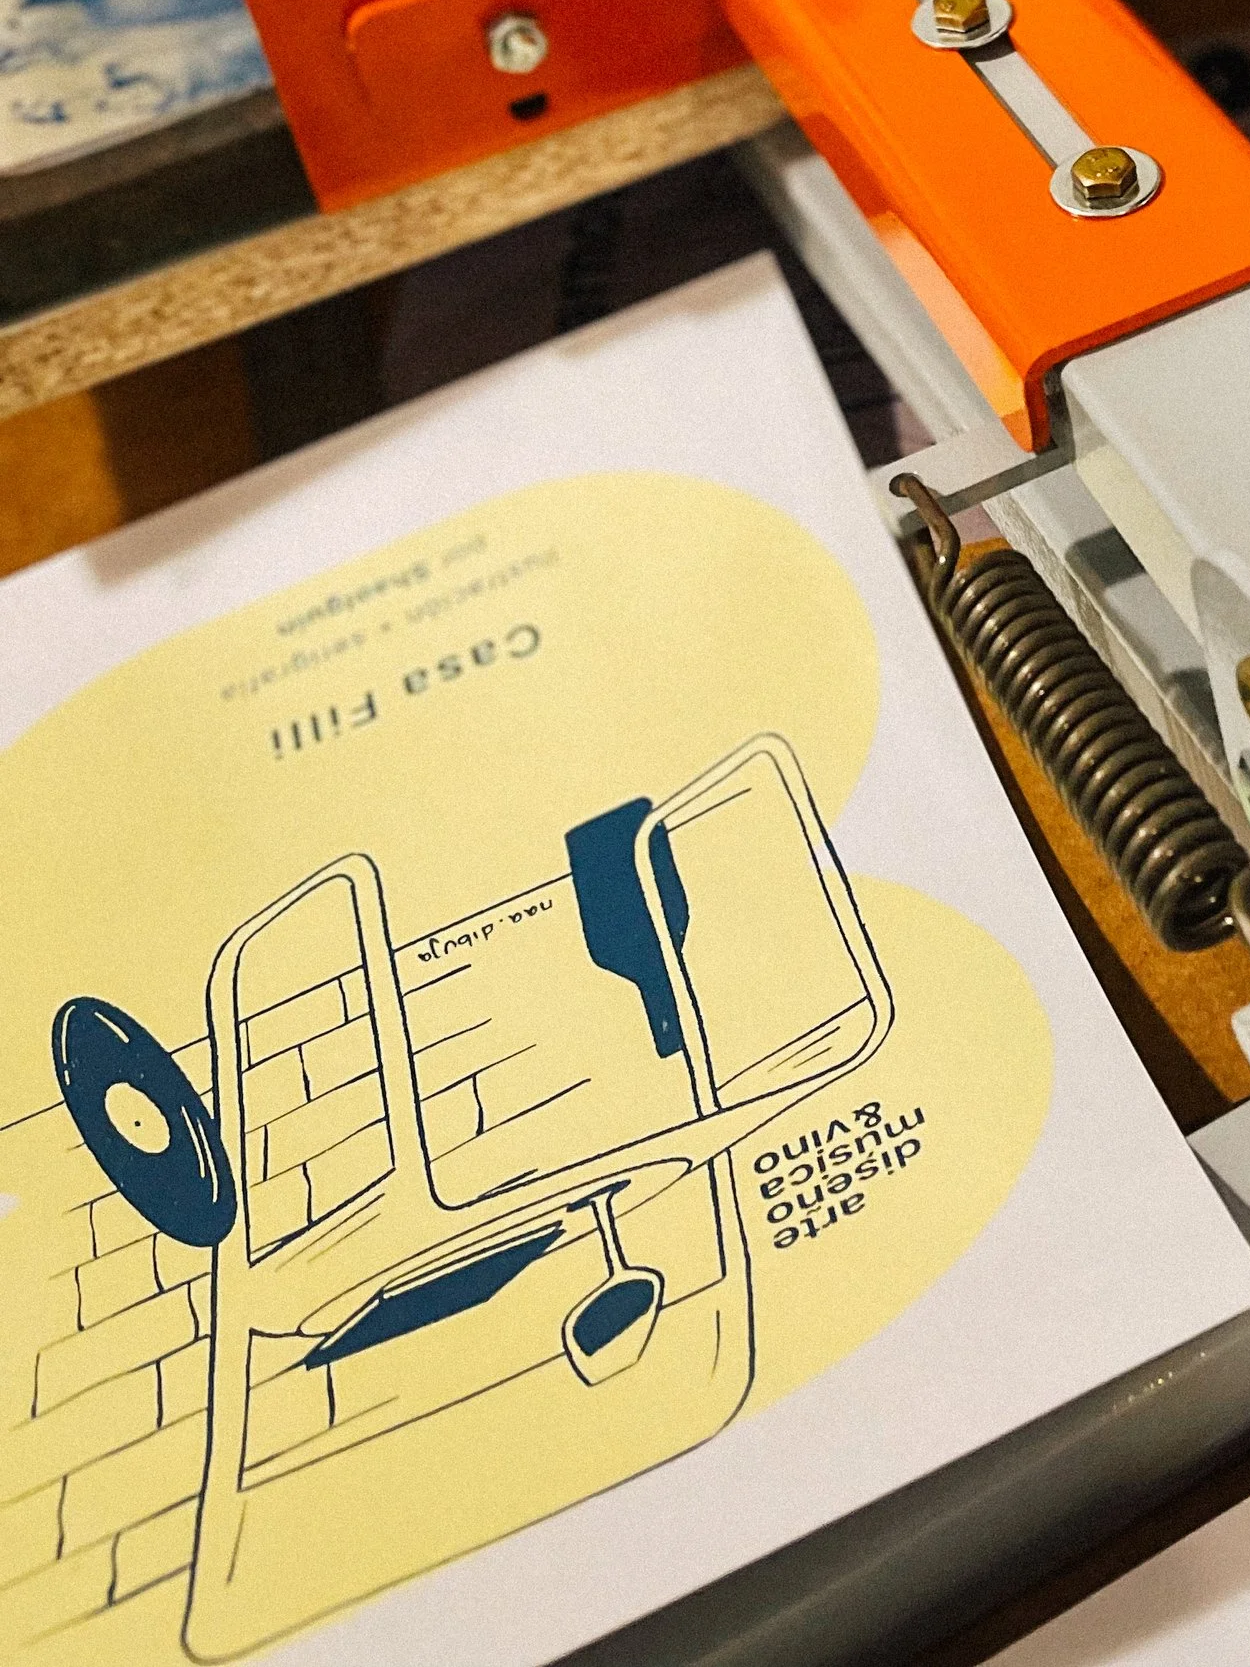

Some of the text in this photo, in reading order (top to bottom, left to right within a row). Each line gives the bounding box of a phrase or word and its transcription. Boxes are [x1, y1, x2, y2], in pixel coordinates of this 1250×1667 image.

[272, 623, 541, 761] Casa Filli
[417, 899, 553, 962] naa.dibuja
[759, 1107, 926, 1200] música
[766, 1138, 921, 1224] diseño
[773, 1192, 865, 1249] arte
